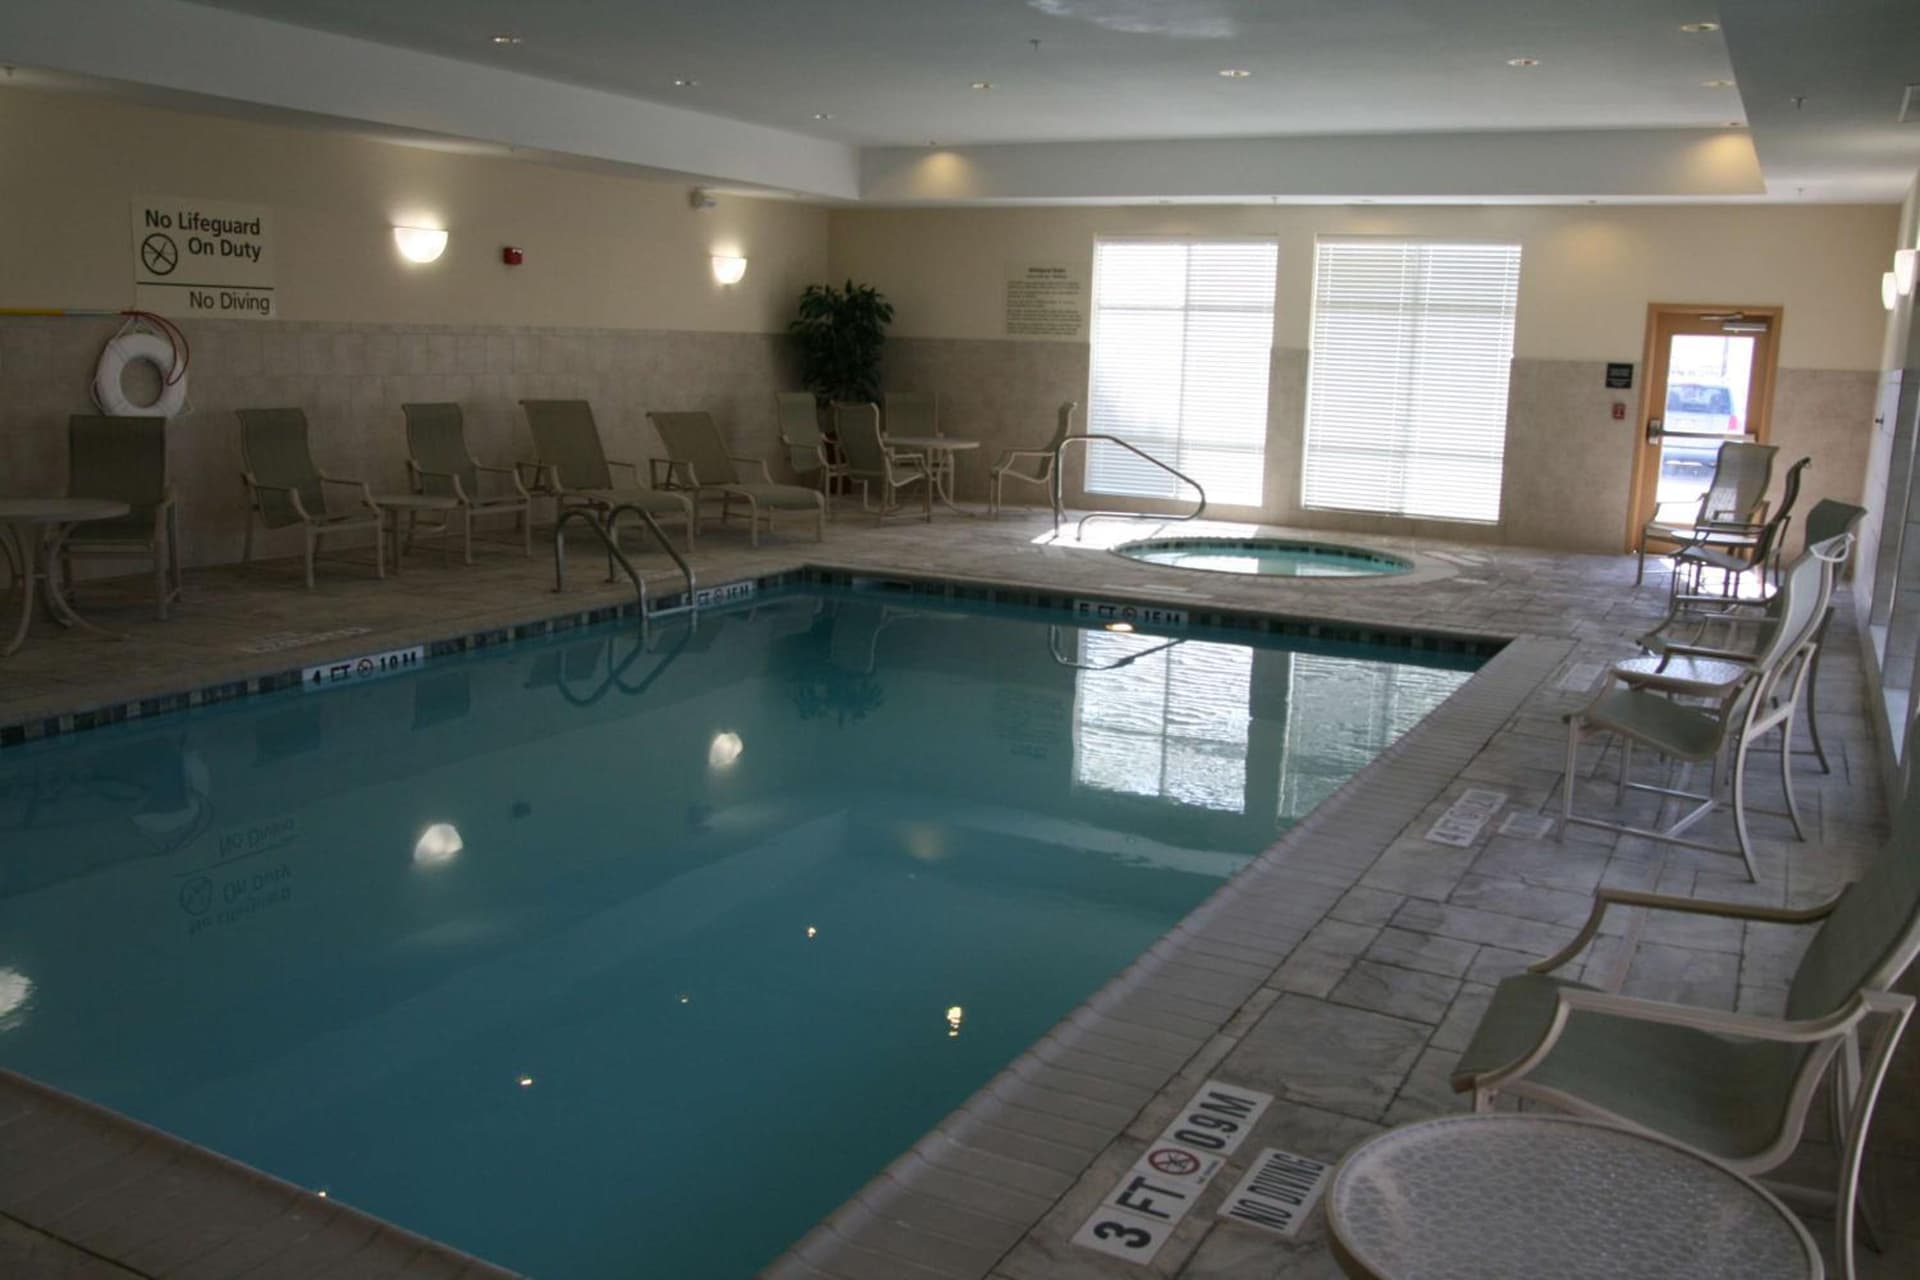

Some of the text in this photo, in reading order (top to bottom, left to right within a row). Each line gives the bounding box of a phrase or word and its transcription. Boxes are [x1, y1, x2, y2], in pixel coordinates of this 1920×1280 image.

[145, 209, 260, 237] No Lifeguard
[188, 237, 262, 262] On Duty
[190, 292, 270, 315] No Diving
[1116, 1176, 1186, 1220] FT
[1230, 1153, 1325, 1231] NO DIVING
[1093, 1220, 1152, 1249] 3
